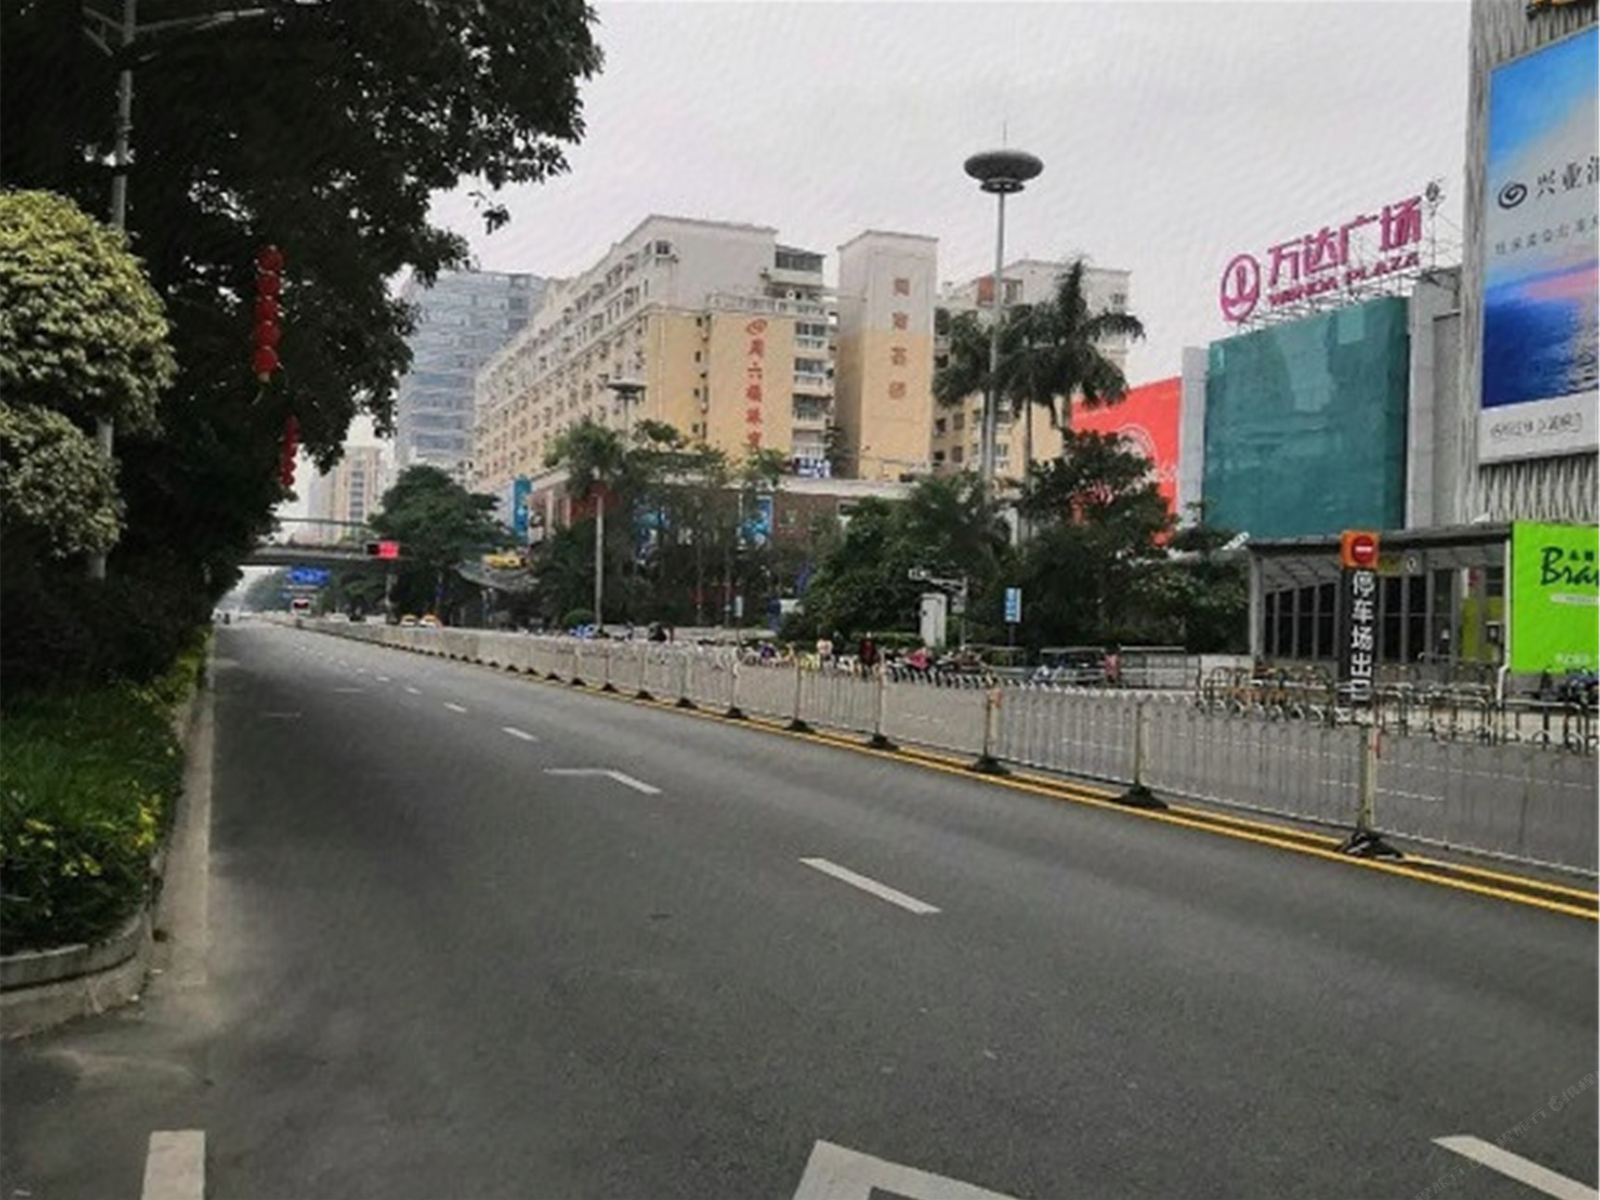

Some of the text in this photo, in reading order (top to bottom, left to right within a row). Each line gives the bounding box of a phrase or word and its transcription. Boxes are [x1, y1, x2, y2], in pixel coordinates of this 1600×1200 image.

[1267, 196, 1423, 287] 万达广场
[1350, 570, 1375, 700] 停车场出口
